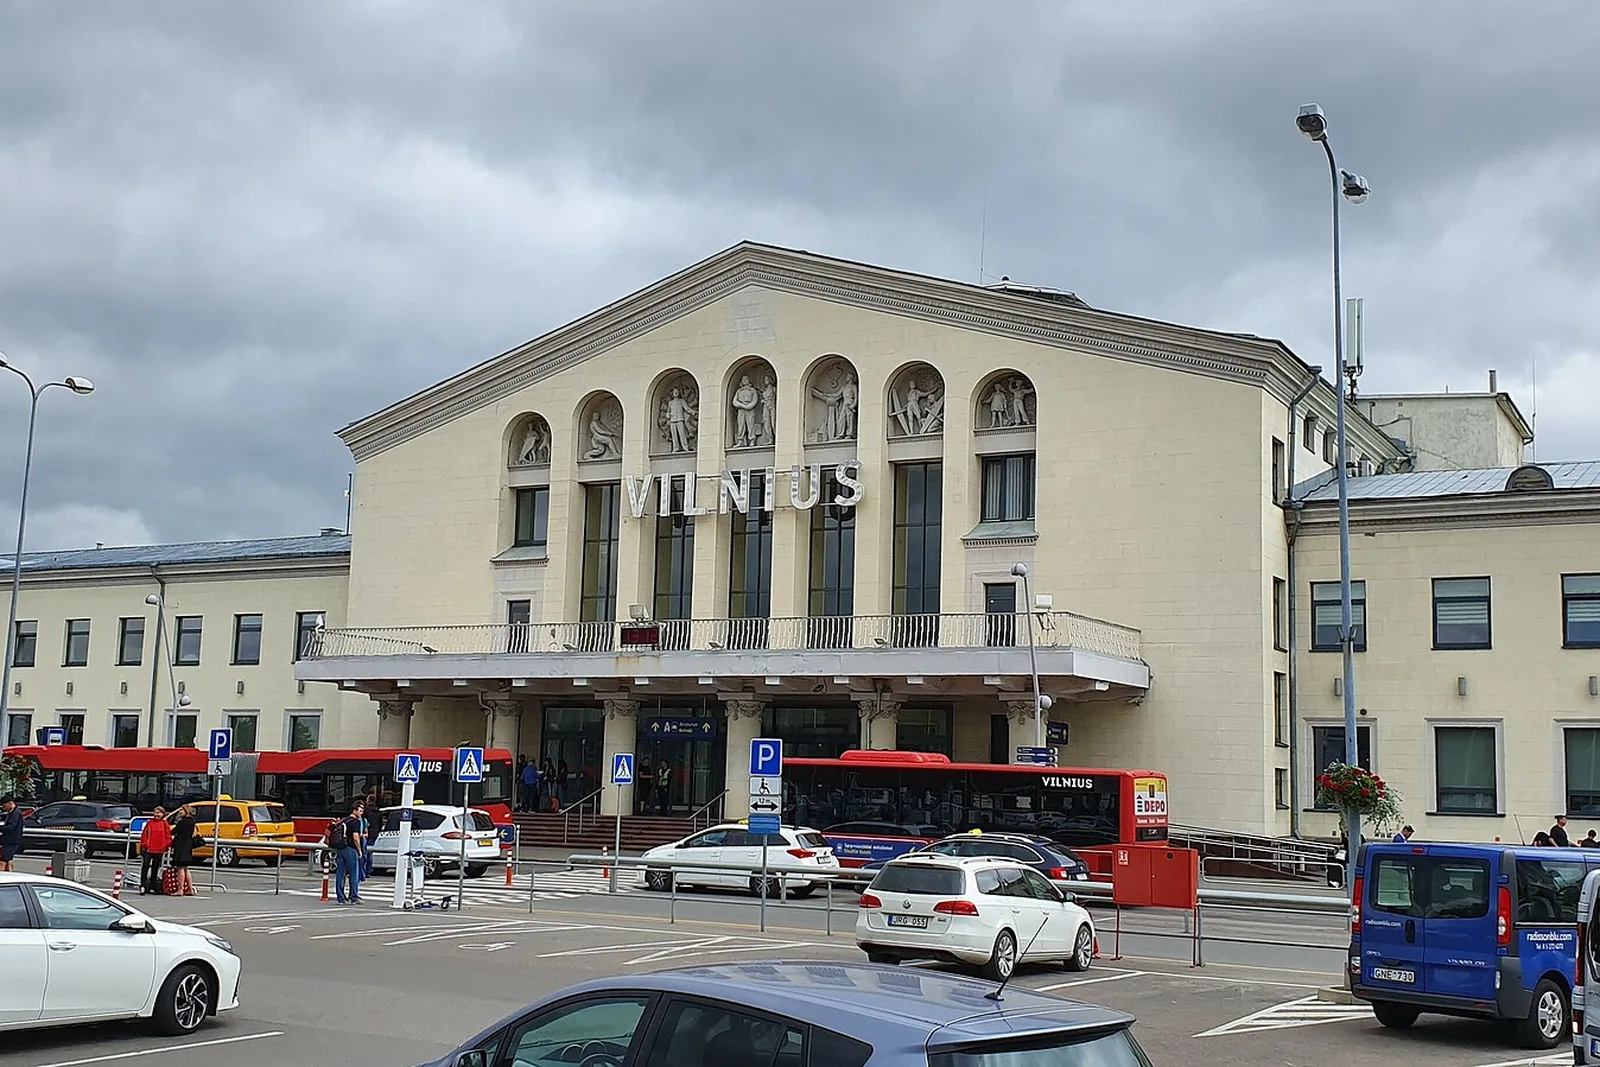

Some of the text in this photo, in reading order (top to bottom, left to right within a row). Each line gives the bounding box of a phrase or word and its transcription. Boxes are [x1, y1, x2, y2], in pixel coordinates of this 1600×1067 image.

[626, 462, 865, 518] VILNIUS
[214, 732, 227, 756] P
[758, 743, 775, 771] P
[1041, 776, 1093, 789] VILNIUS
[1144, 800, 1165, 813] DEPO
[912, 917, 926, 926] 055
[1527, 930, 1573, 941] radissonblu.com
[1374, 968, 1414, 983] GNE 730
